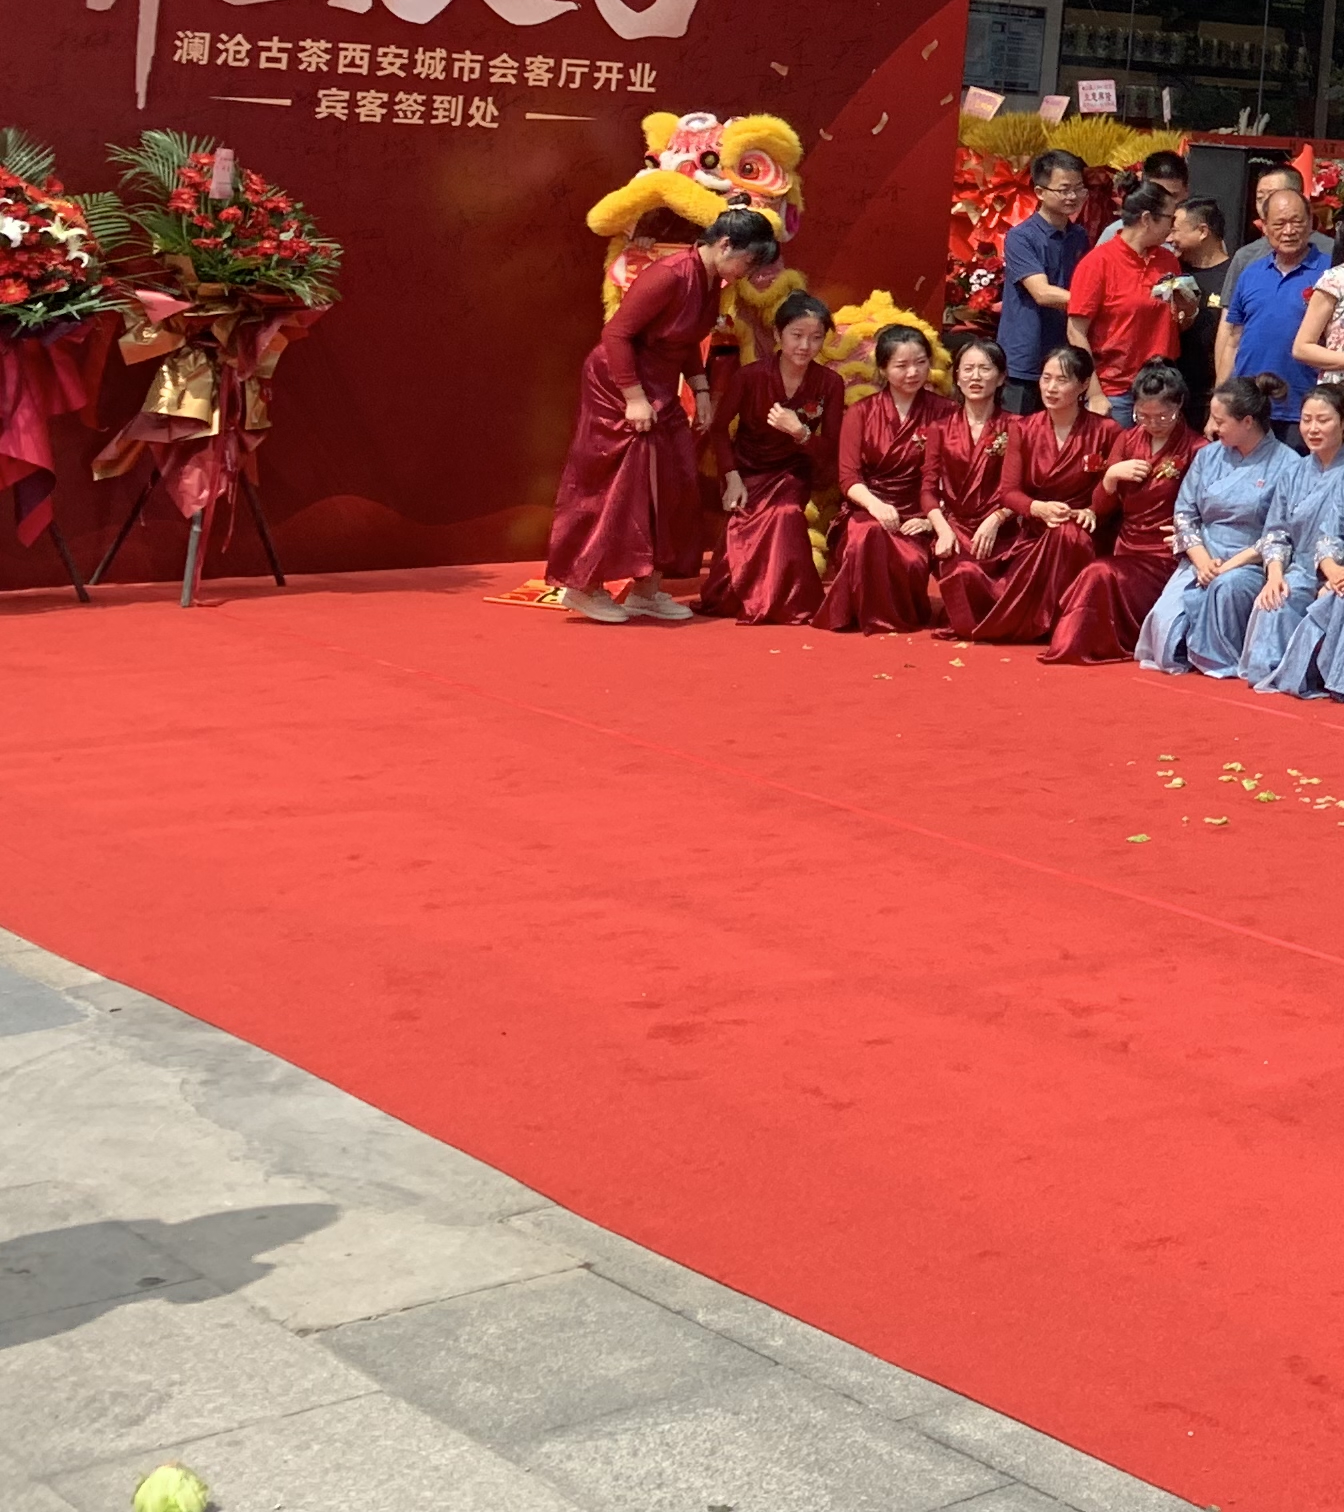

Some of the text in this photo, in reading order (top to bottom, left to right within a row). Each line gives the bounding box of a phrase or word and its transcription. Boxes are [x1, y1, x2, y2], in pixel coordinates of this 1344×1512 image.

[173, 29, 658, 93] 澜沧古茶西安城市会客厅开业
[315, 89, 500, 129] 宾客签到处
